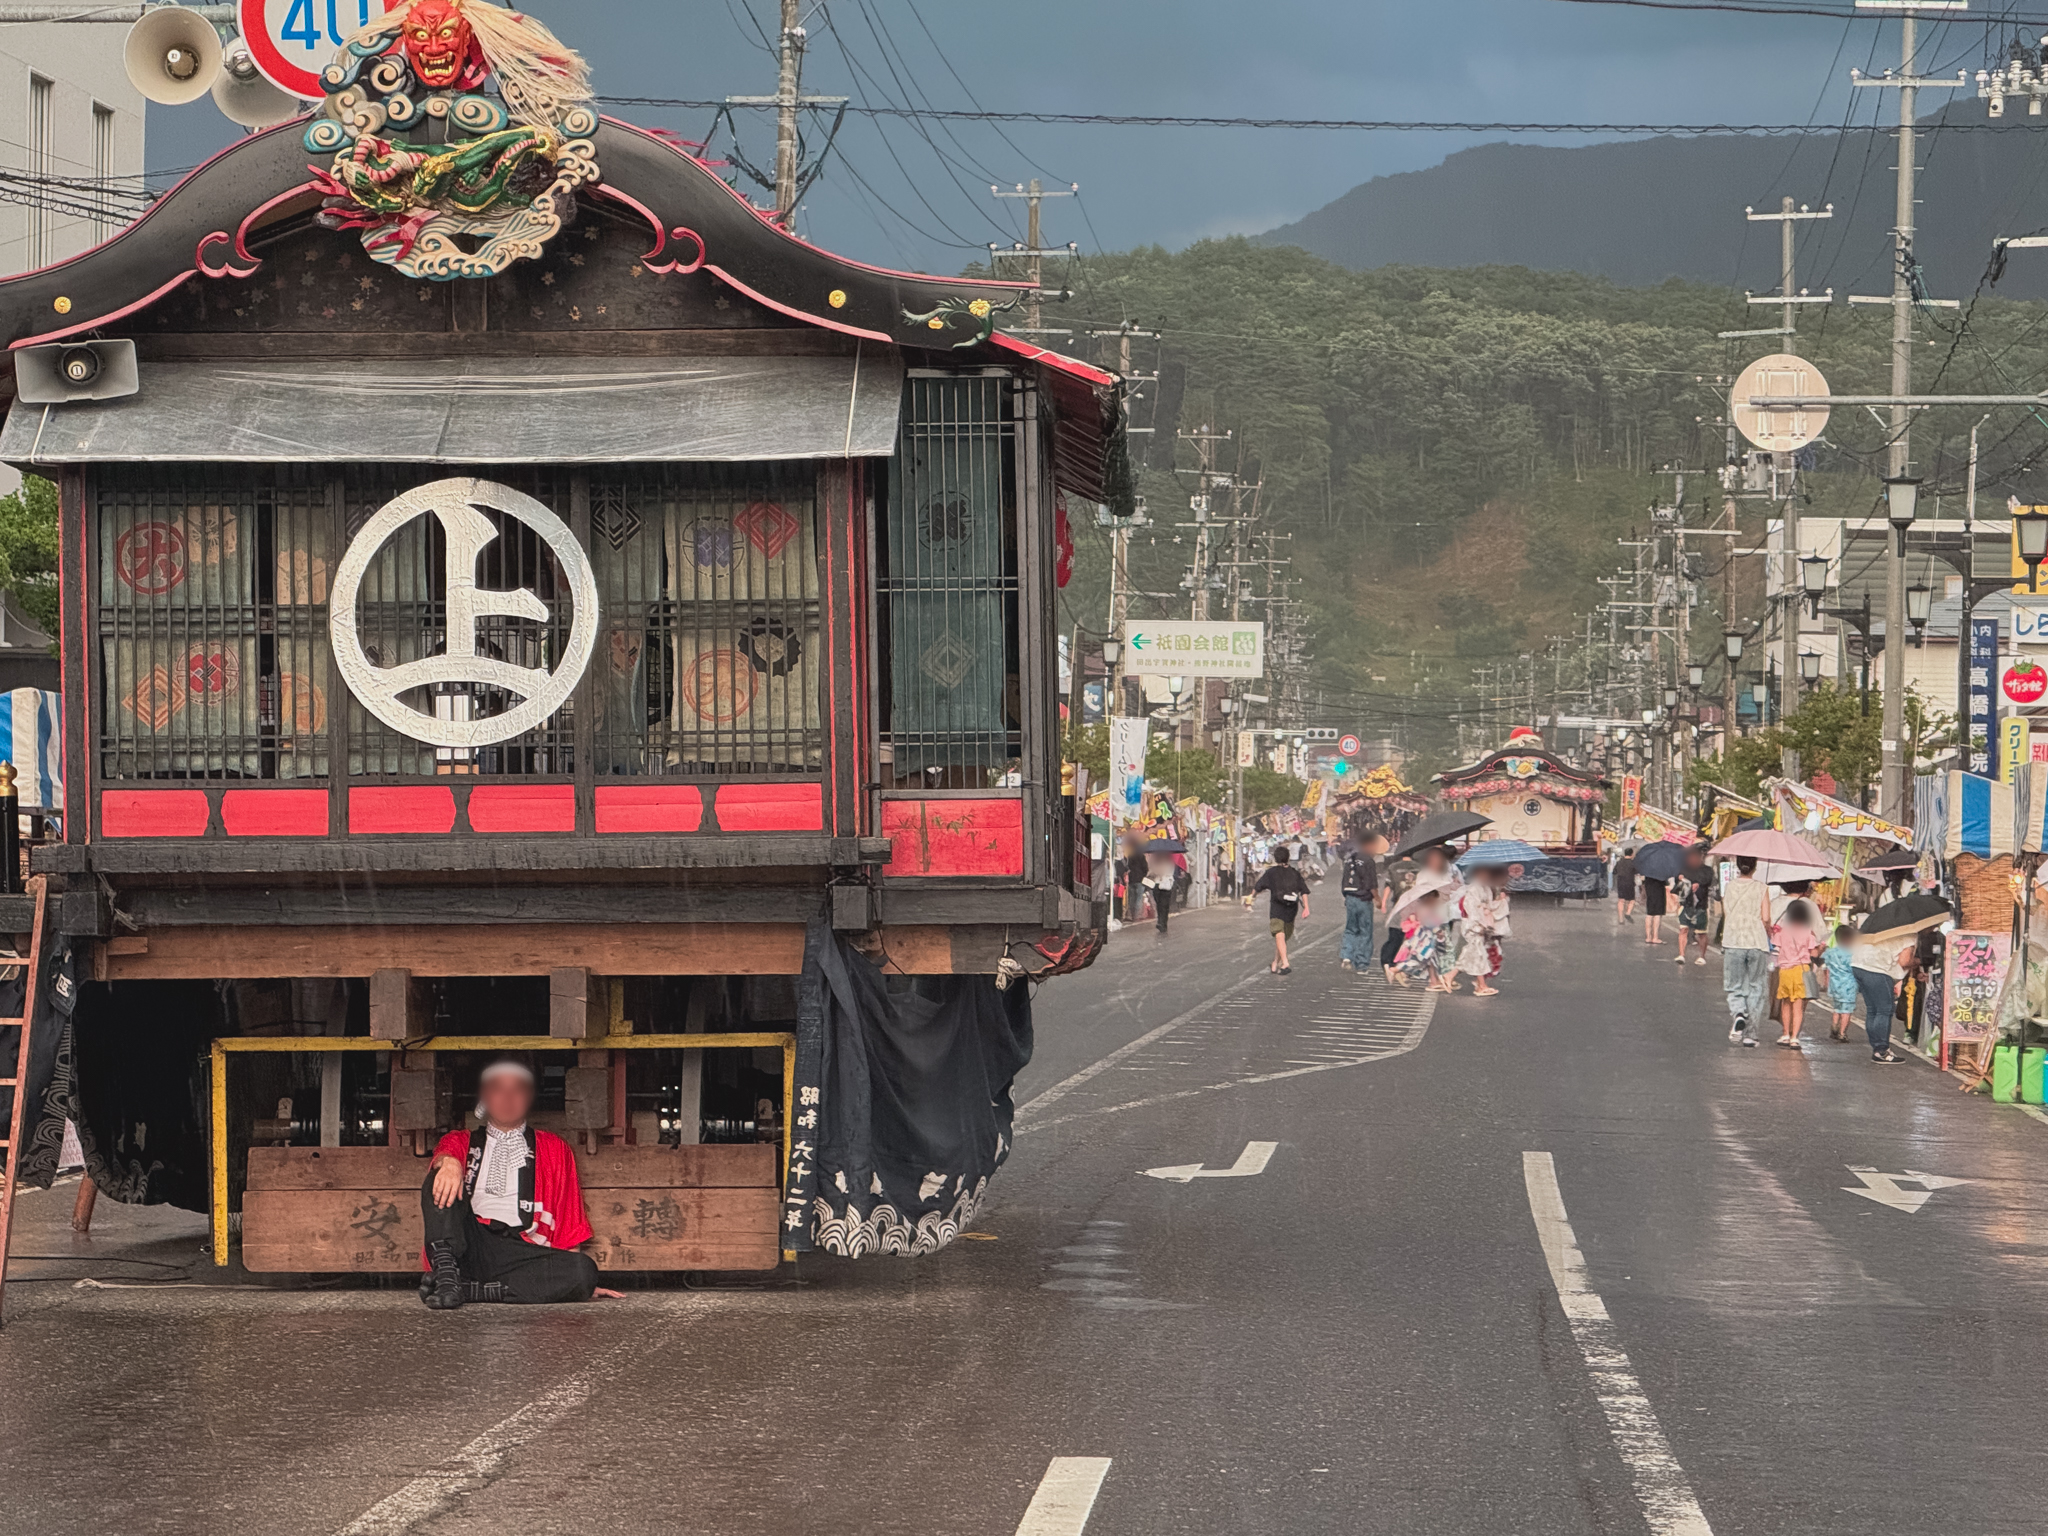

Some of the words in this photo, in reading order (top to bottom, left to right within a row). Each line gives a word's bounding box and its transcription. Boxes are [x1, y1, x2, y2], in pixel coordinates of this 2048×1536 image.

[1157, 634, 1229, 651] 祇園会館
[1344, 740, 1355, 749] 40
